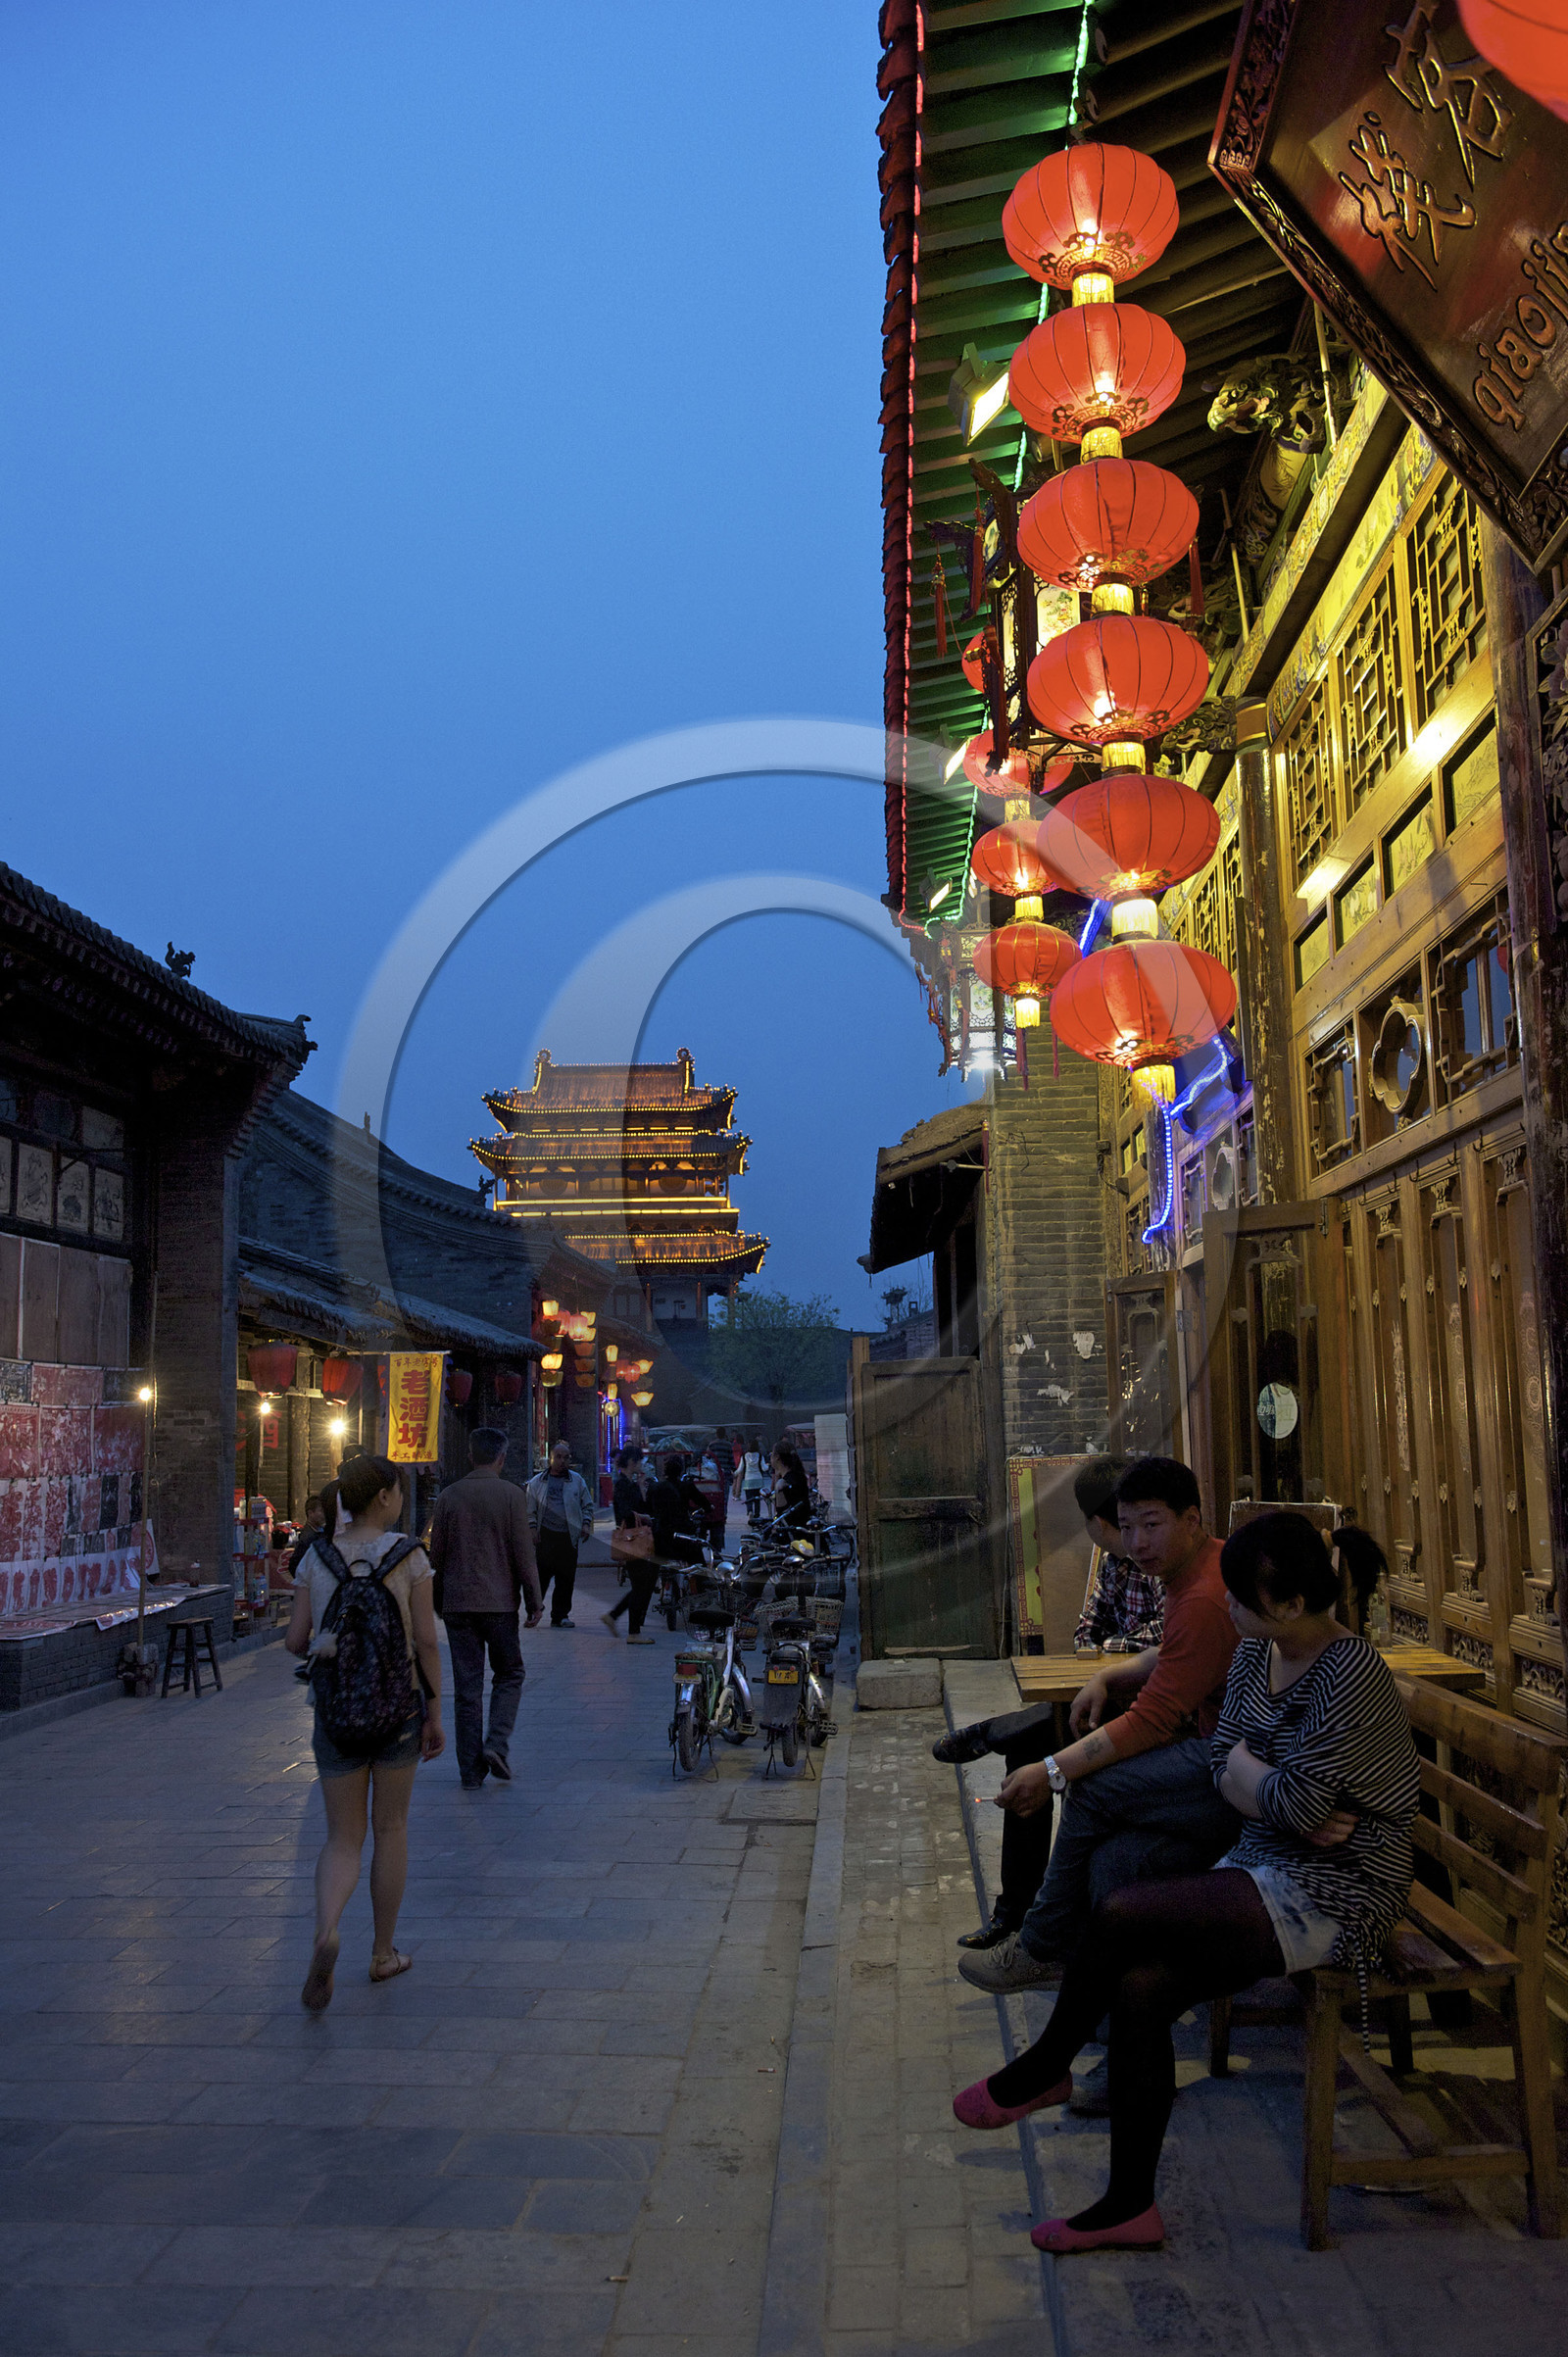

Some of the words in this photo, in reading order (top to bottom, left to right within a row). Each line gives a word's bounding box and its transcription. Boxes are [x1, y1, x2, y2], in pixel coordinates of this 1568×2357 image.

[394, 1356, 439, 1368] 百年老字号
[398, 1369, 430, 1449] 老酒坊
